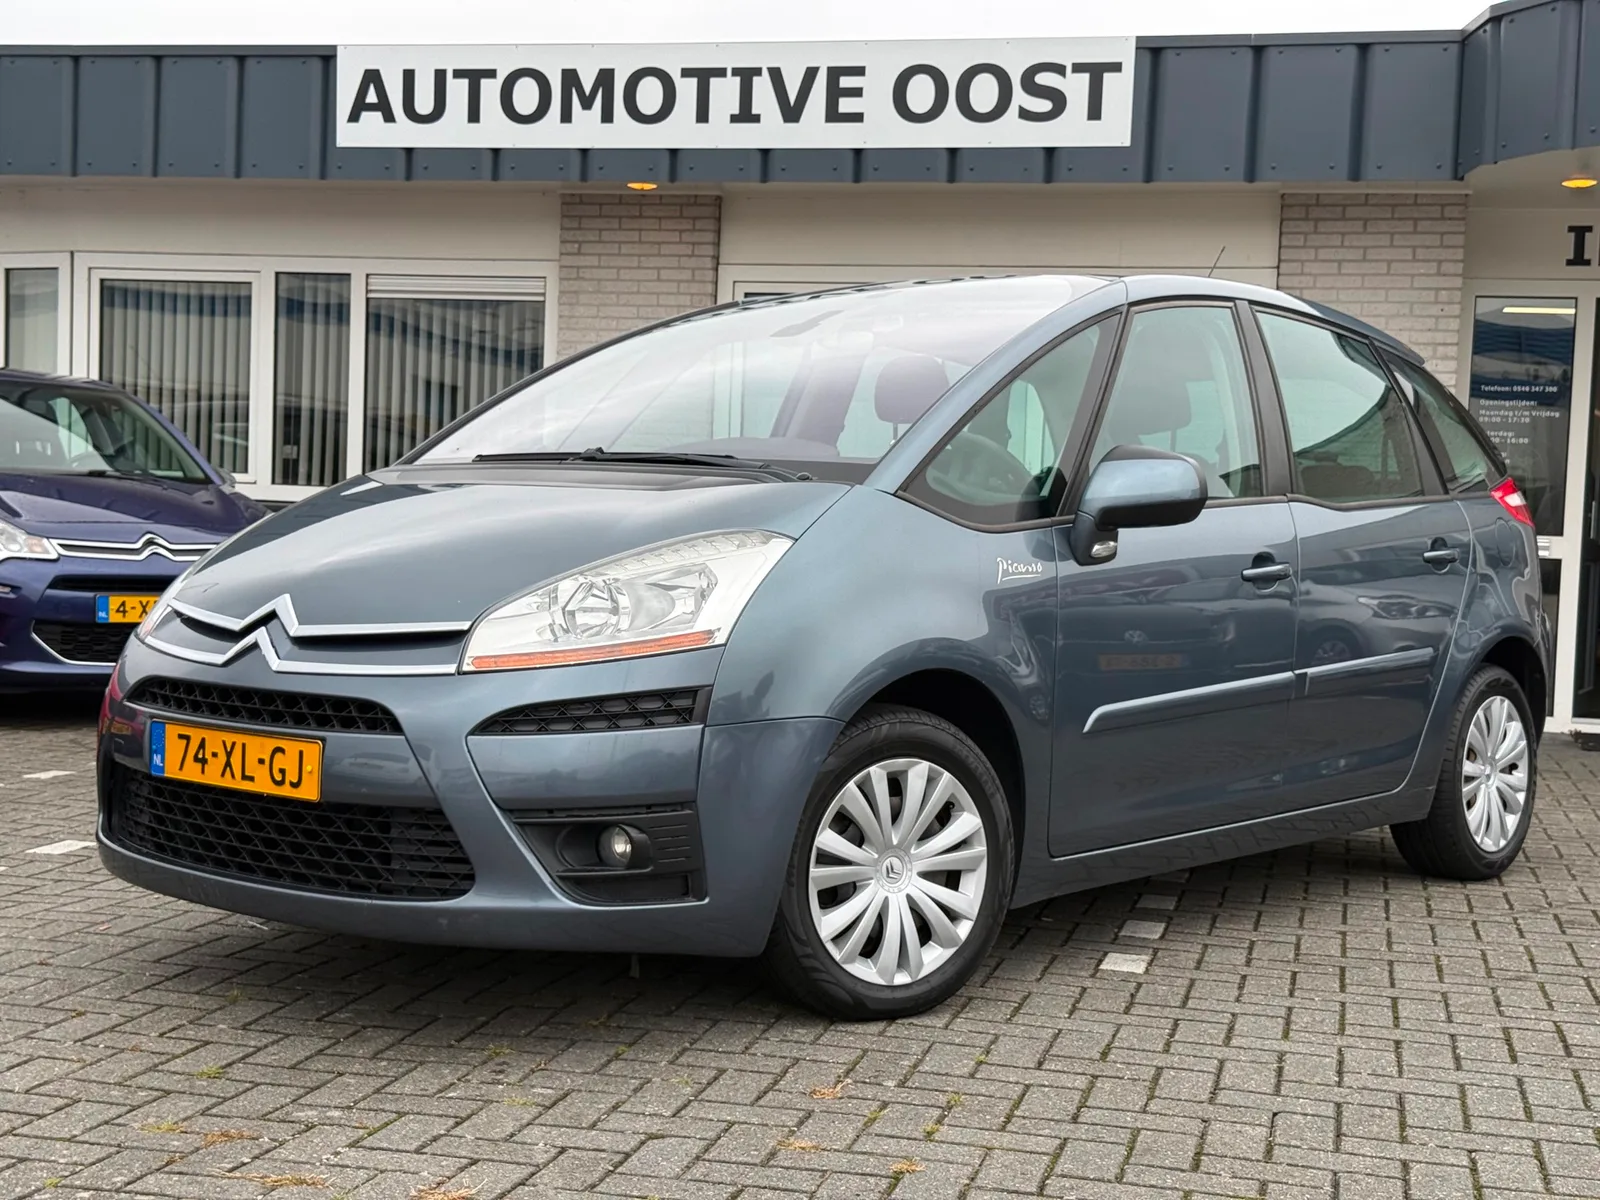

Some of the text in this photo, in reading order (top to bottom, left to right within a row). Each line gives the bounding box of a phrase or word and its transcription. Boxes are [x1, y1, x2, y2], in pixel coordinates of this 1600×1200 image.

[346, 61, 1123, 125] AUTOMOTIVE OOST
[1565, 225, 1600, 266] I
[1479, 409, 1513, 417] Maandag
[1531, 410, 1560, 418] Vrijdag
[996, 557, 1042, 584] Picasso
[115, 600, 158, 618] 4-X
[153, 753, 163, 766] NL
[177, 733, 304, 789] 74-XL-GJ
